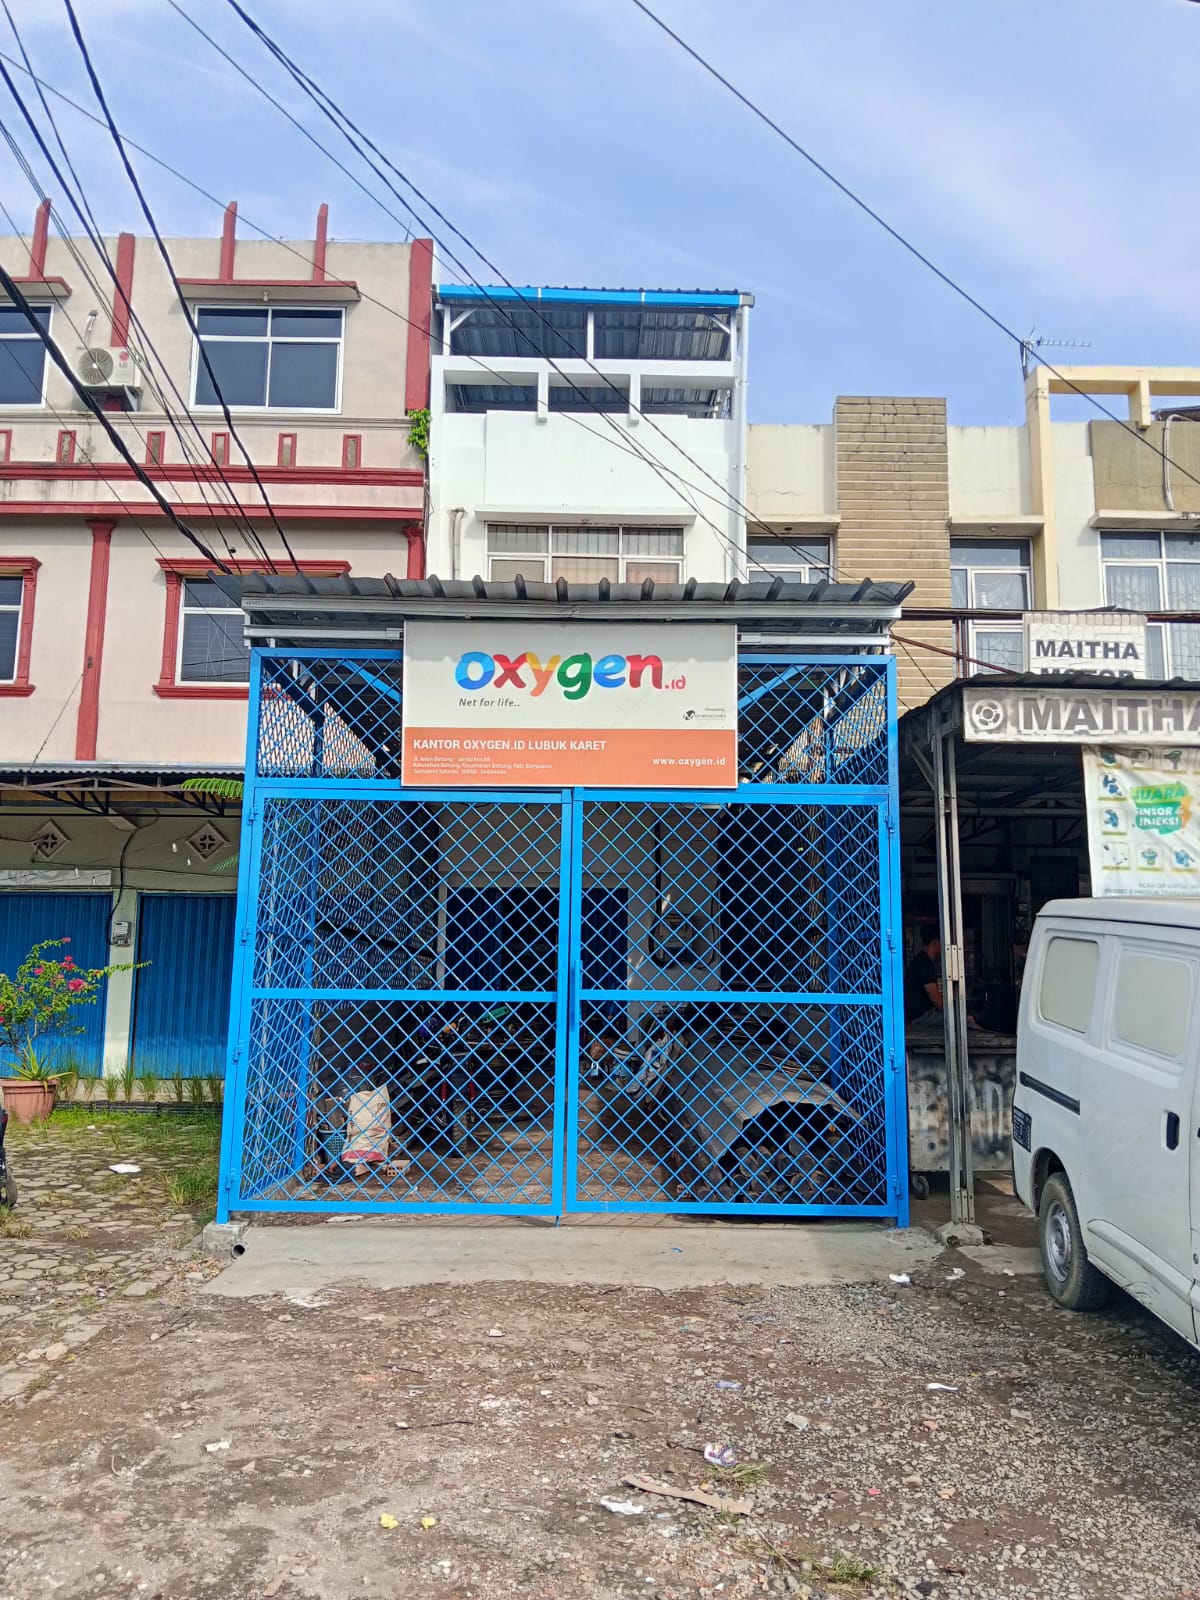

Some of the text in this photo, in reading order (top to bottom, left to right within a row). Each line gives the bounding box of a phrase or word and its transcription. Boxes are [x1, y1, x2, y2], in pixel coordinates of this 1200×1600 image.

[1035, 639, 1139, 660] MAITHA
[455, 651, 686, 700] oxygen.id
[459, 697, 521, 707] Net for life..
[413, 739, 607, 751] KANTOR OXYGEN.ID LUBUK KARET
[652, 756, 726, 768] www.oxygen.id
